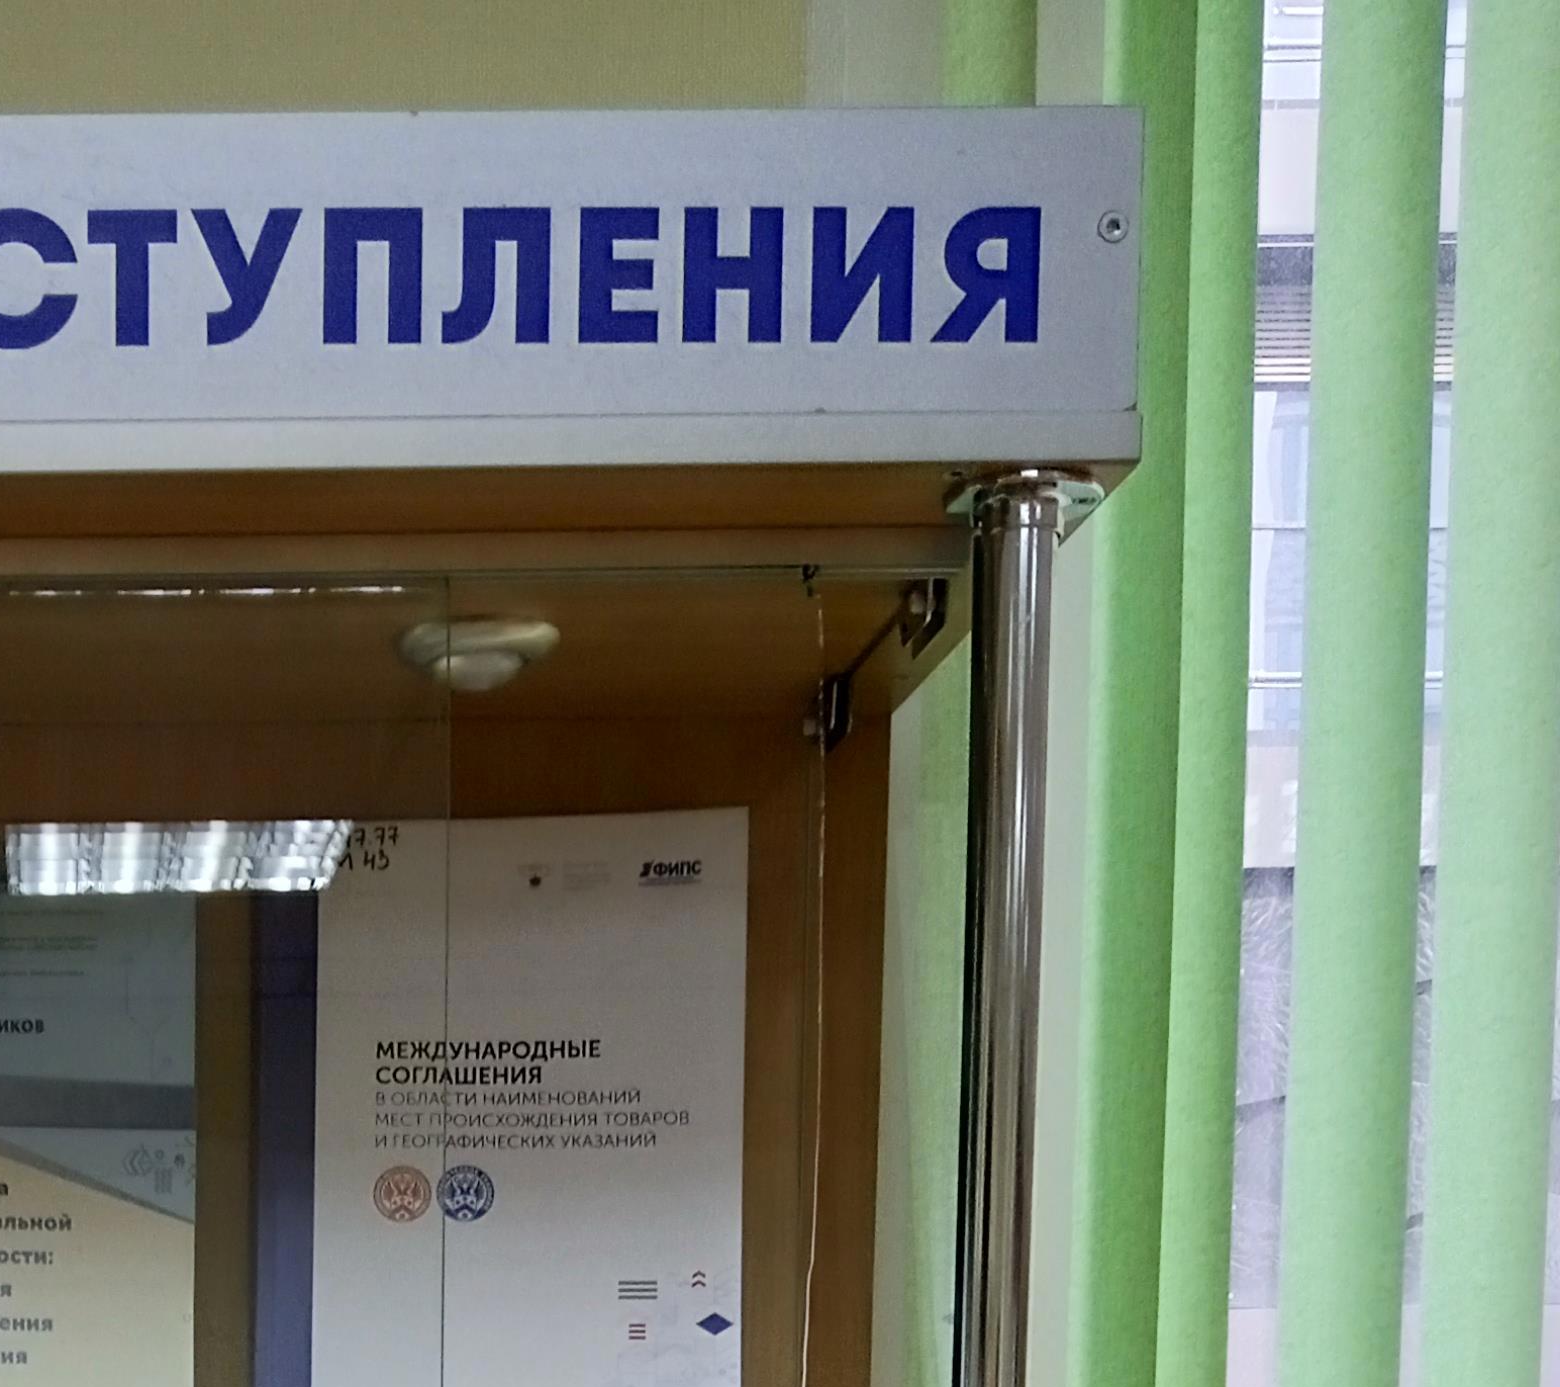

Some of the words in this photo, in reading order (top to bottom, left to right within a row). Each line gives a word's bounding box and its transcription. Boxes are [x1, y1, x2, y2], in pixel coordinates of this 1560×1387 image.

[653, 859, 702, 877] ФИПС
[375, 1039, 601, 1062] МЕЖДУНАРОДНЫЕ
[375, 1066, 542, 1086] СОГЛАШЕНИЯ
[376, 1092, 385, 1105] В
[391, 1091, 477, 1106] ОБЛАСТИ
[482, 1088, 640, 1105] НАИМЕНОВАНИЙ
[376, 1112, 423, 1127] МЕСТ
[429, 1112, 597, 1129] ПРОИСХОЖДЕНИЯ
[606, 1110, 689, 1127] ТОВАРОВ
[375, 1135, 387, 1148] И
[392, 1134, 554, 1148] ГЕОГРАФИЧЕСКИХ
[561, 1131, 656, 1148] УКАЗАНИЙ
